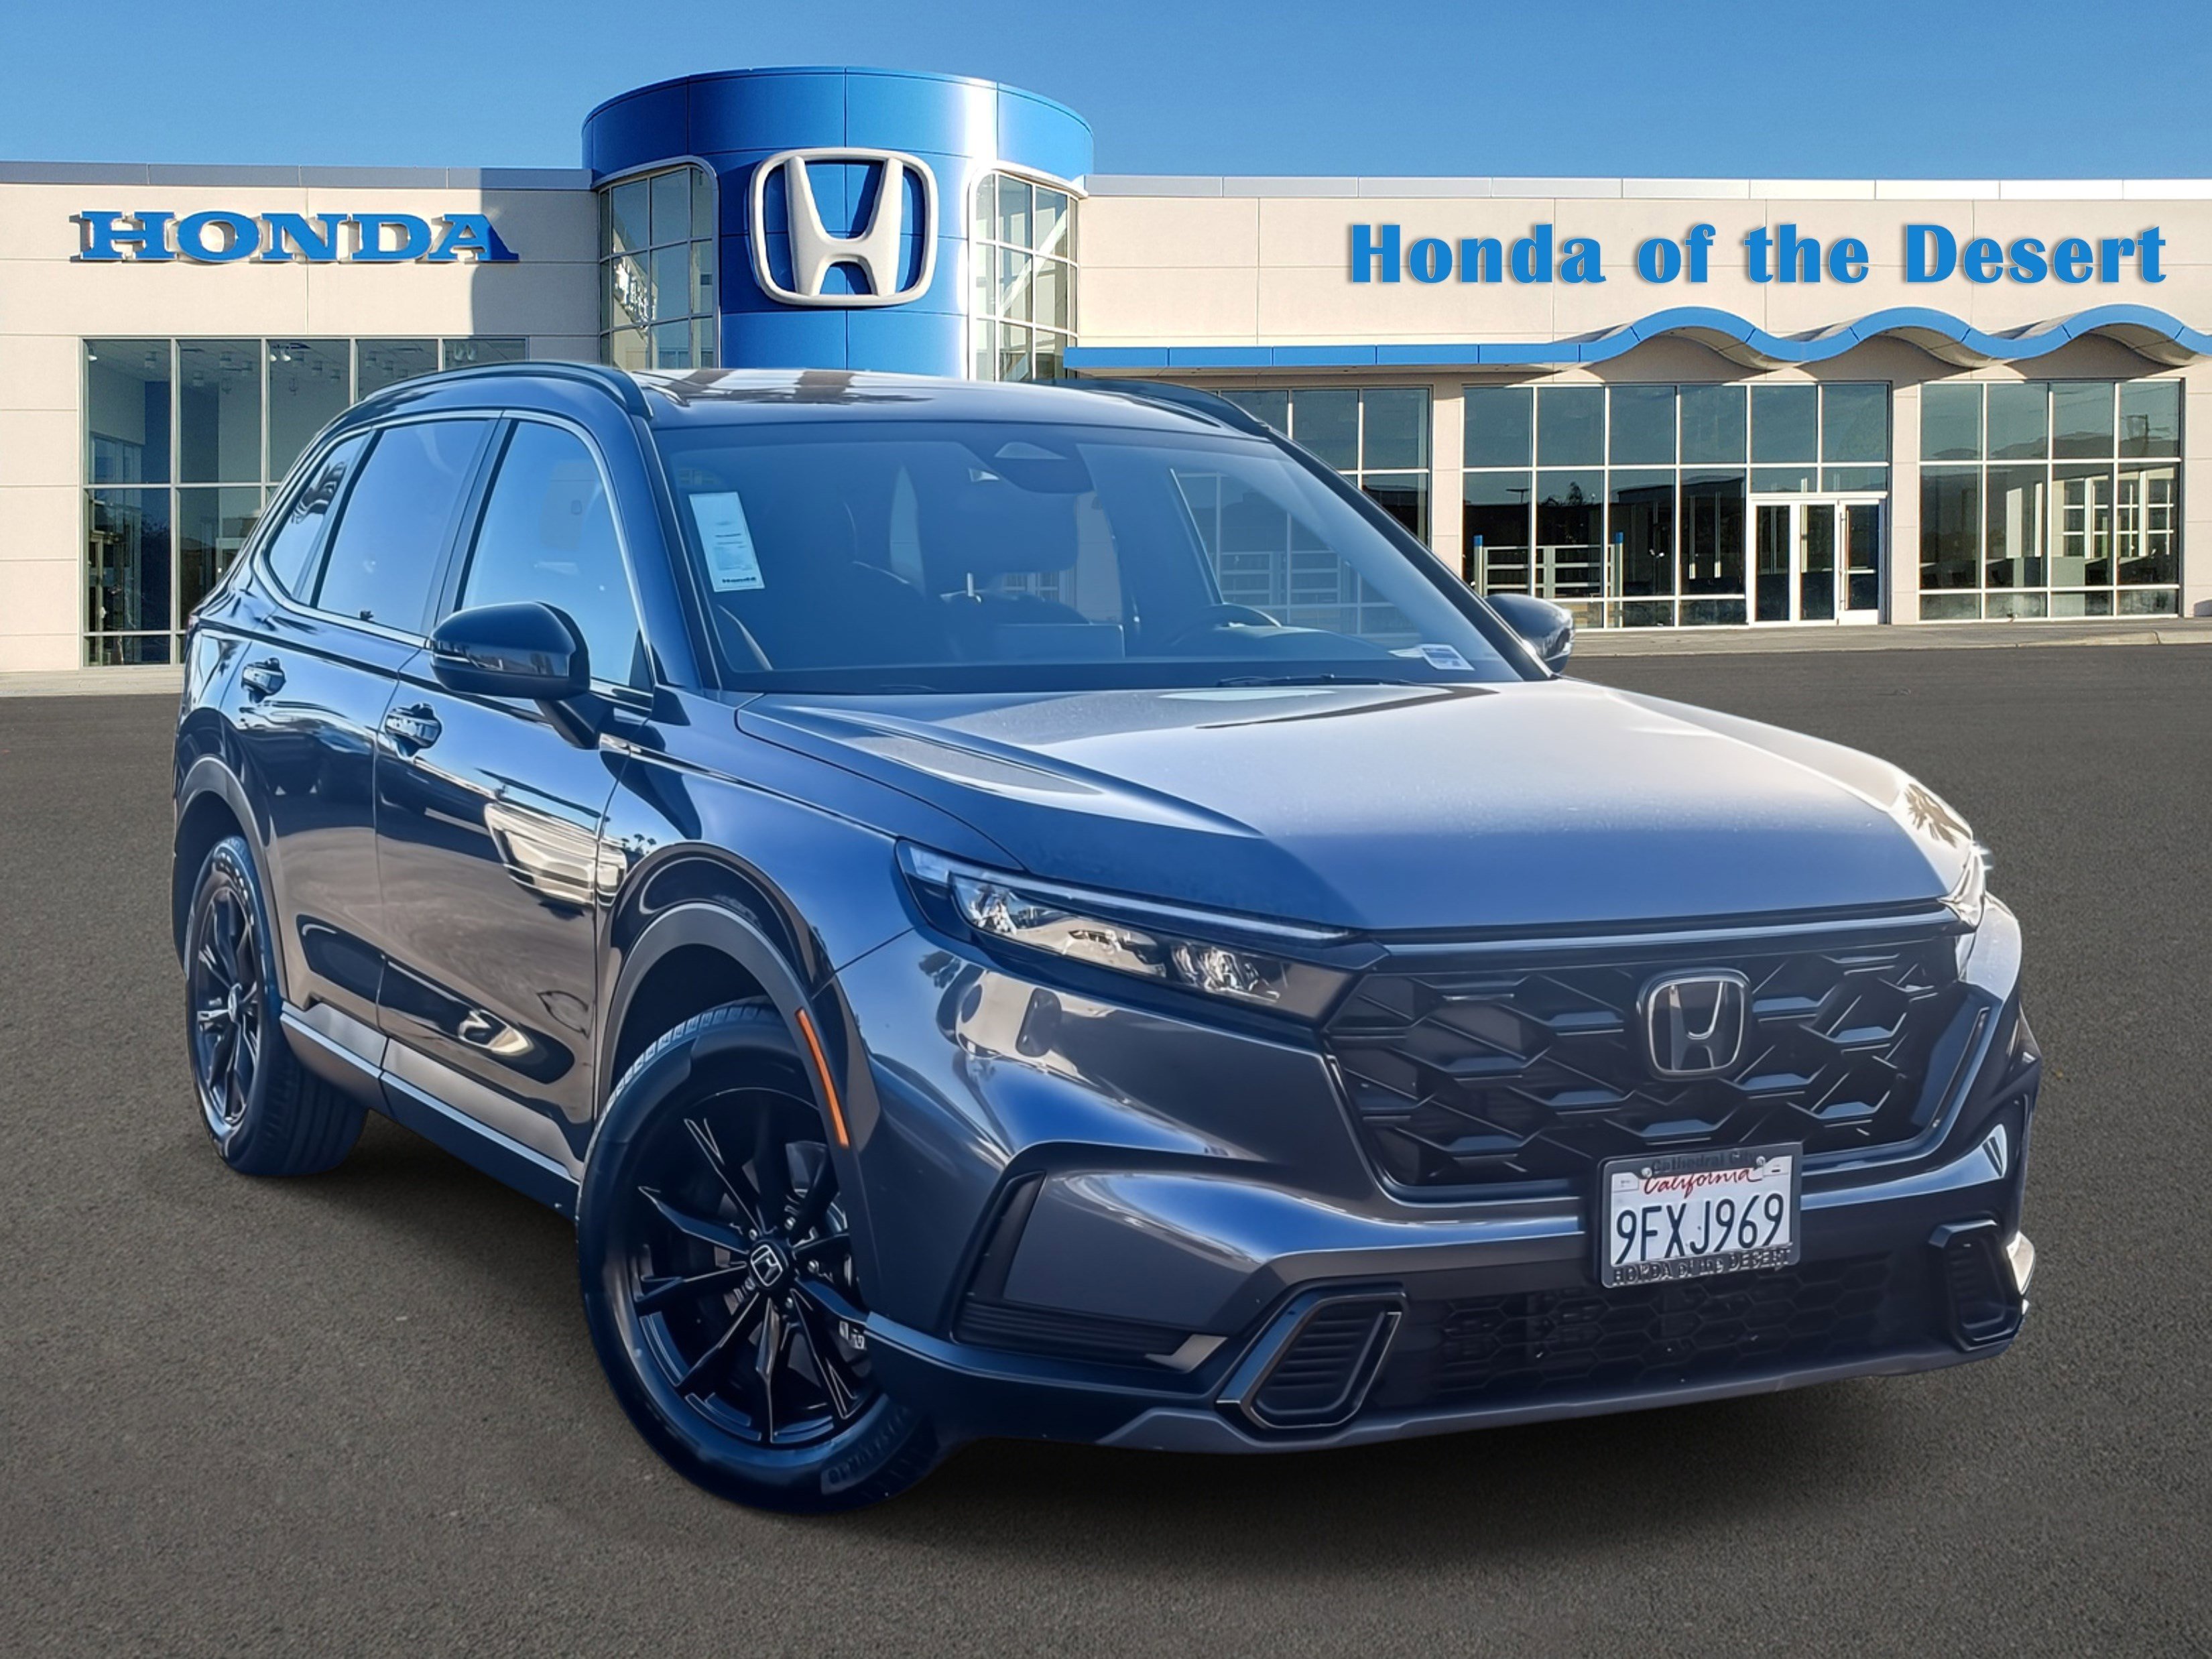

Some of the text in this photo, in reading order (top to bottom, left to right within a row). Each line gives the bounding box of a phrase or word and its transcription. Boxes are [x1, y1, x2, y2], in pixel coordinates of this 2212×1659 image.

[80, 210, 519, 261] HONDA
[1351, 223, 2167, 284] Honda of the Desert
[1644, 1168, 1763, 1199] California
[1615, 1192, 1784, 1265] 9FXJ969
